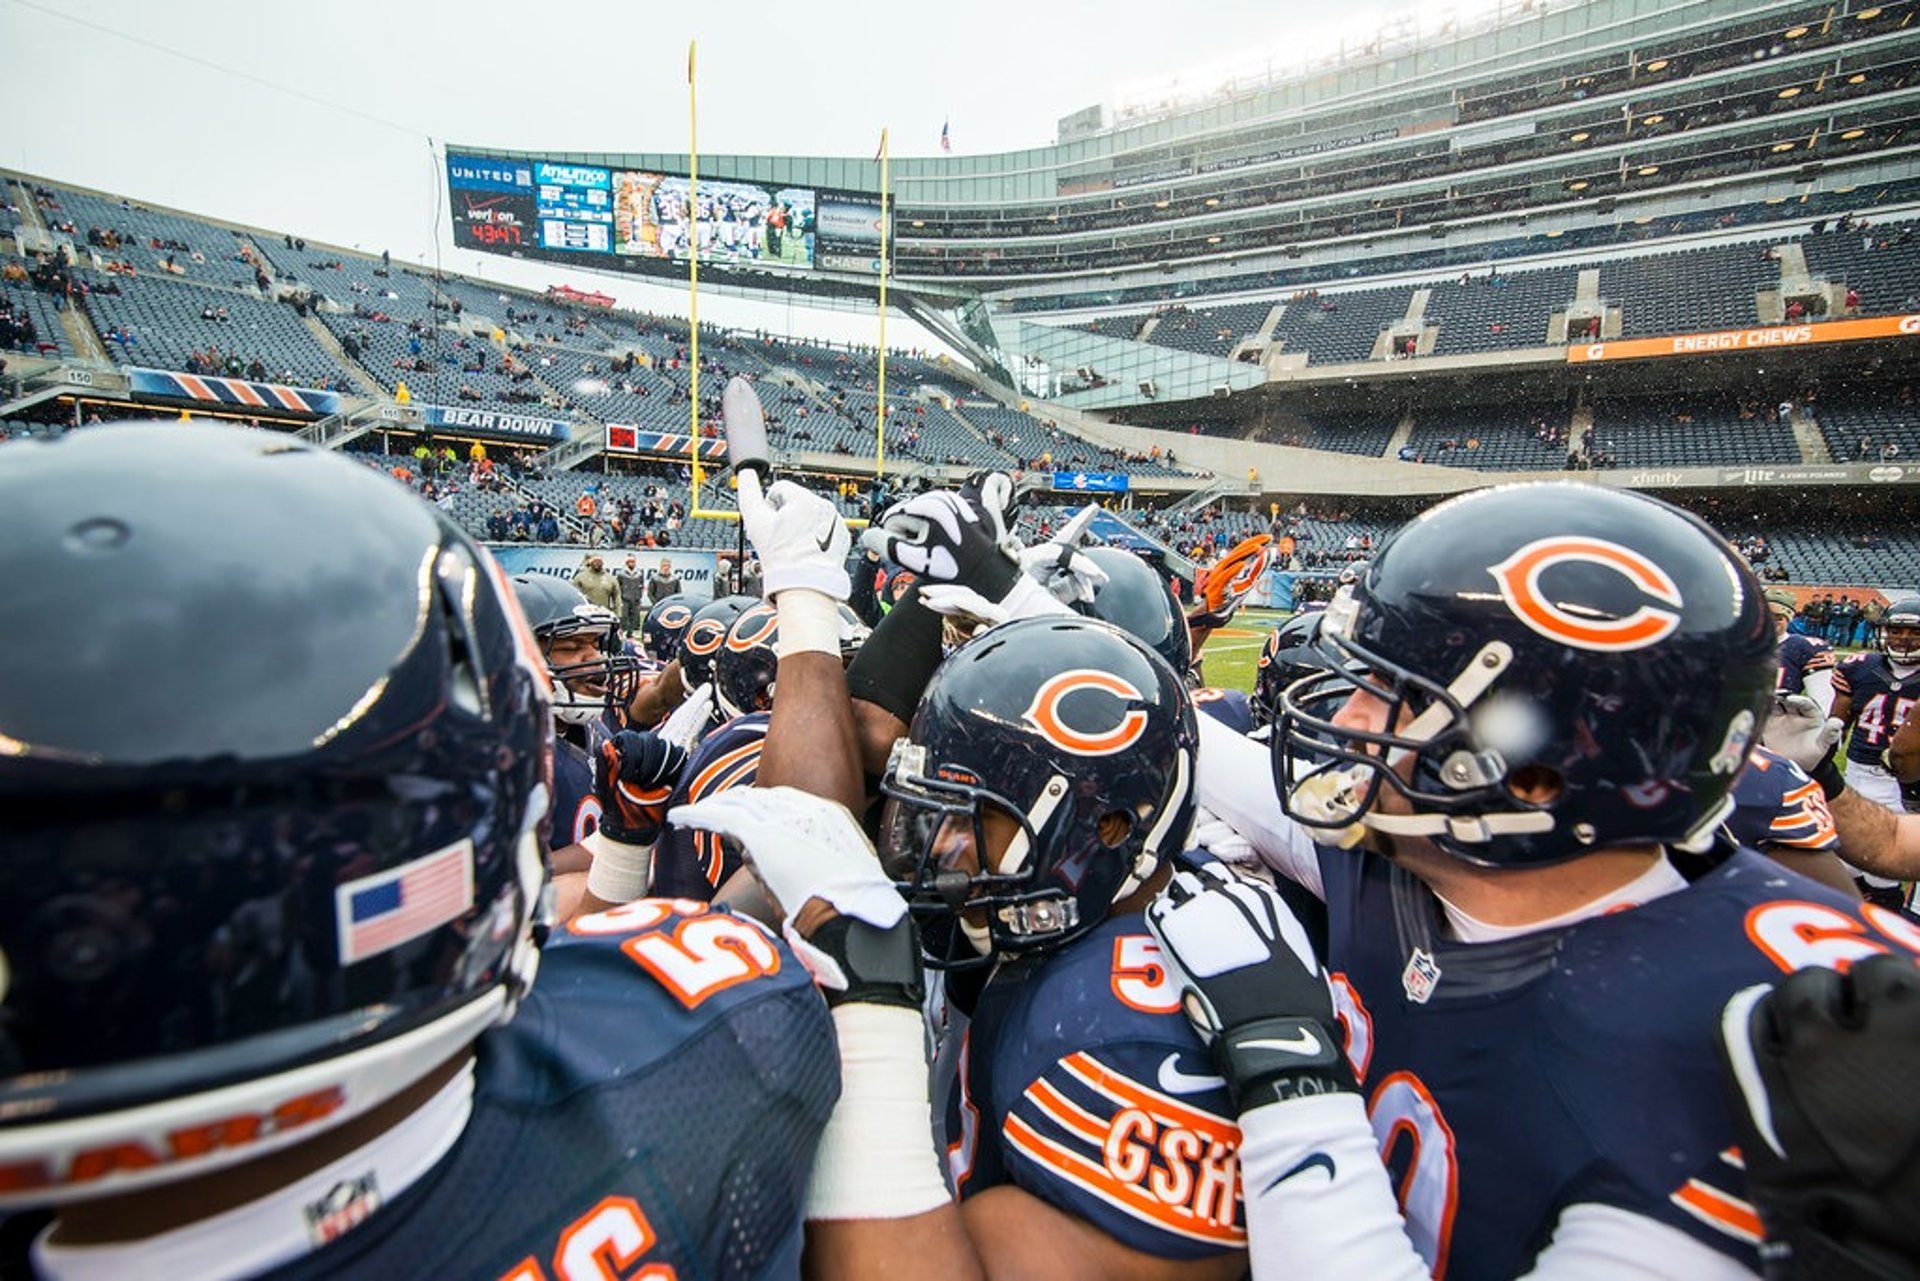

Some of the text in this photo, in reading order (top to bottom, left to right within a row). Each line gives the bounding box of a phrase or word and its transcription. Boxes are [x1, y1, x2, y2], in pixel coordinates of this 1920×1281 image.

[451, 167, 513, 181] UNITED
[1673, 333, 1742, 353] ENERGY
[1746, 326, 1813, 347] CHEWS
[70, 371, 92, 384] 150
[442, 409, 553, 436] BEAR DOWN
[1631, 472, 1683, 486] xfinity
[1105, 1108, 1238, 1228] GSH
